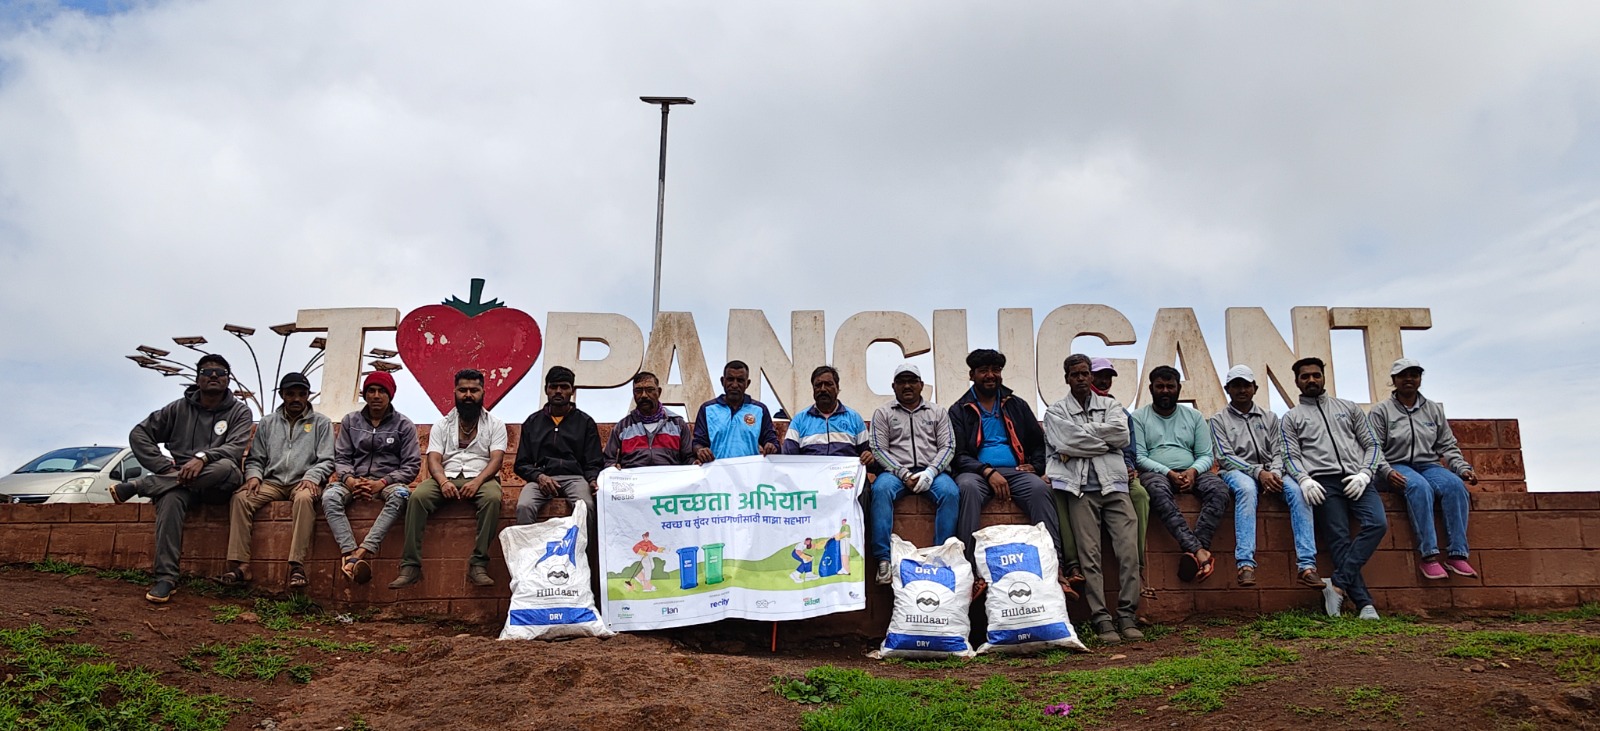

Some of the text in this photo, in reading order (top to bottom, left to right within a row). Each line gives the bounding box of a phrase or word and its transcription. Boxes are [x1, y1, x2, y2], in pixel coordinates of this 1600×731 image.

[650, 484, 818, 515] स्वच्छता अभियान
[661, 520, 682, 530] स्वच्छ
[693, 516, 709, 530] सुंदर
[711, 513, 760, 525] पांचगणीसाठी
[762, 515, 782, 525] माझा
[783, 515, 811, 526] सहभाग
[1001, 552, 1024, 566] DRY
[915, 566, 939, 575] DRY
[710, 598, 730, 608] recity
[549, 612, 563, 620] DRY
[661, 606, 678, 615] Plan
[1001, 604, 1045, 618] Hilldaari
[905, 614, 949, 626] Hilldaari
[1018, 632, 1031, 641] DRY
